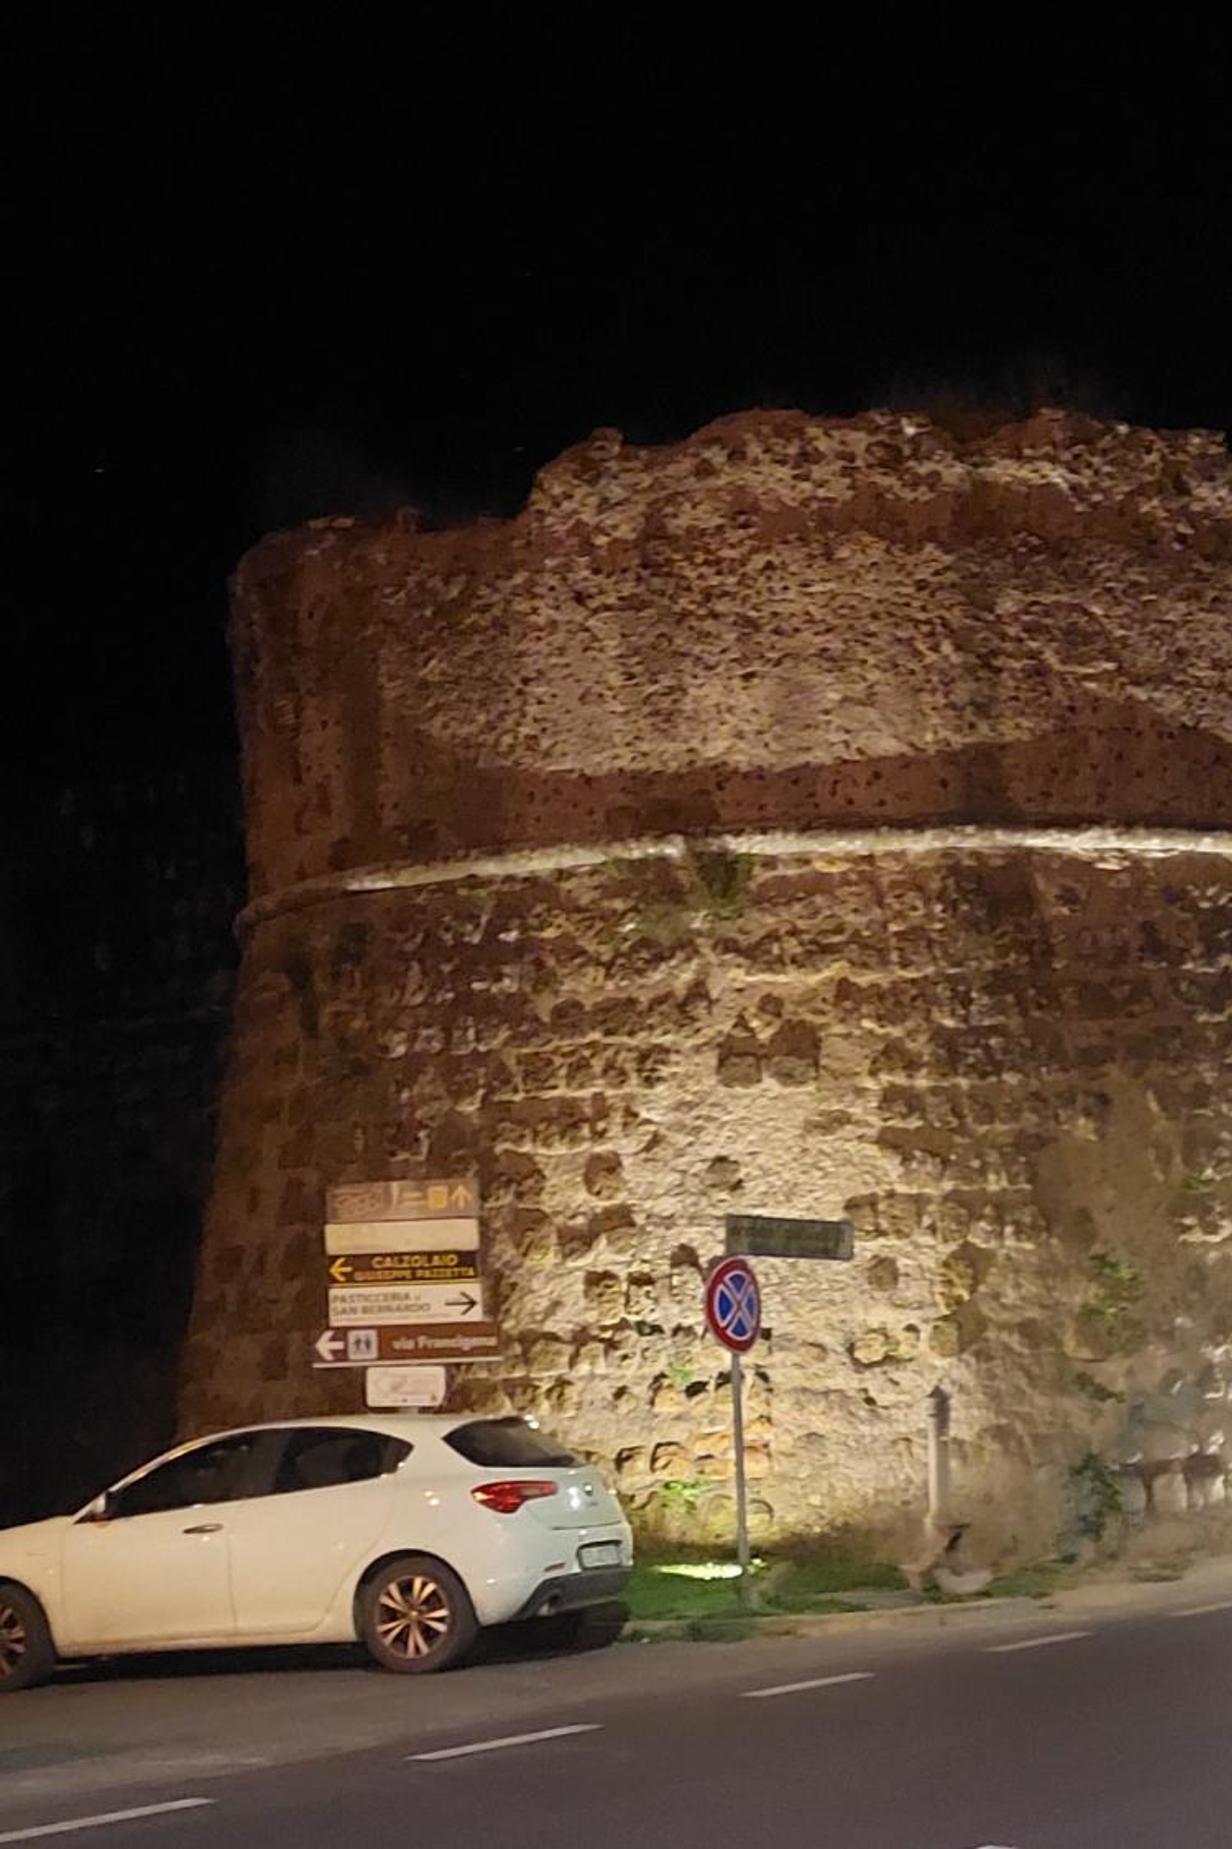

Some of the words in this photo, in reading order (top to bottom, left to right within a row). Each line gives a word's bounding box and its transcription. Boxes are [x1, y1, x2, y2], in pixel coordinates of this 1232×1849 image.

[371, 1254, 459, 1269] CALZOLAIO
[332, 1291, 410, 1304] PASTICCERIA
[332, 1305, 358, 1316] SAN
[392, 1336, 415, 1350] via
